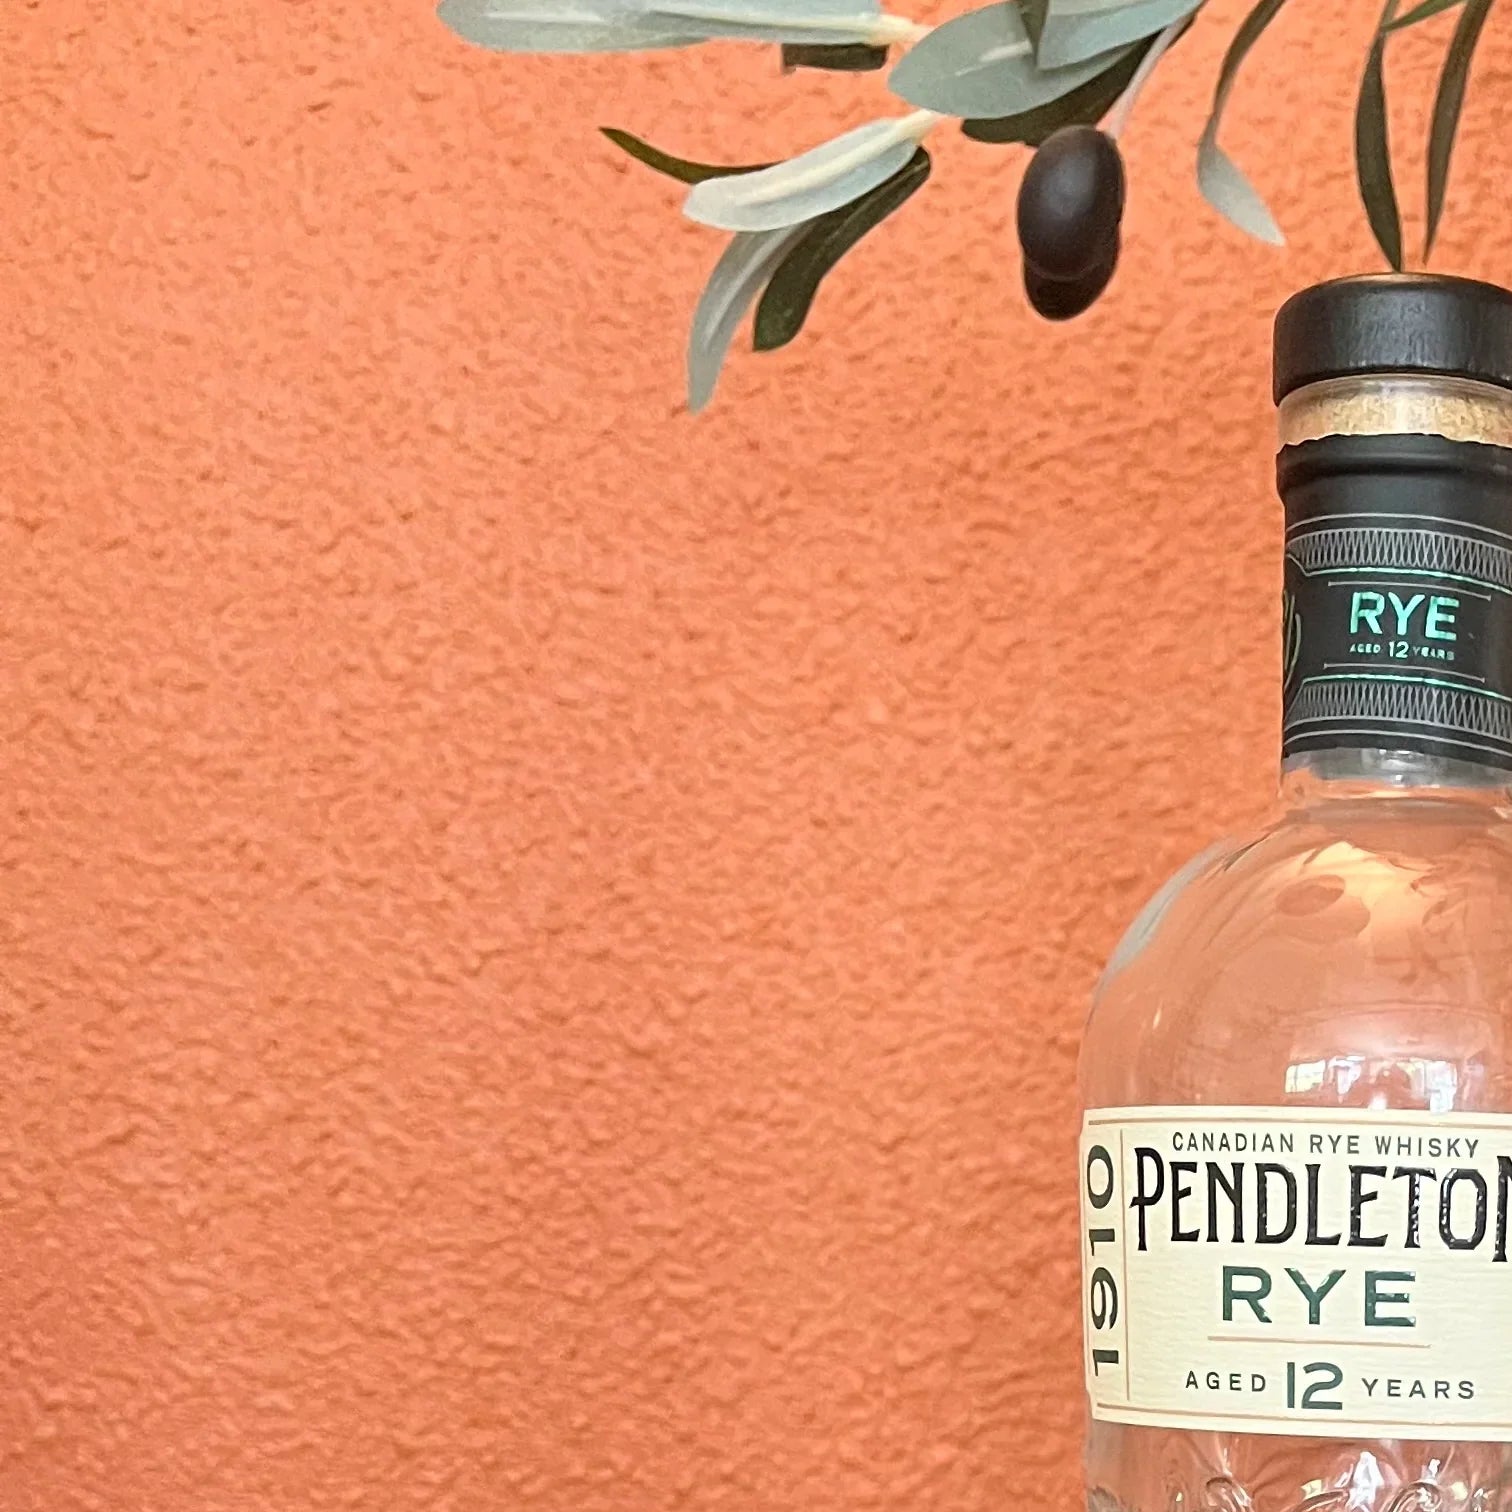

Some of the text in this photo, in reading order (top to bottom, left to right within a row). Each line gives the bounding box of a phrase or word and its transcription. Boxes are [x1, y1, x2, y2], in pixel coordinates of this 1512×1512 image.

[1350, 591, 1460, 641] RYE
[1350, 641, 1455, 661] AGED 12 YEARS
[1172, 1131, 1480, 1158] CANADIAN RYE WHISKY
[1087, 1144, 1120, 1377] 1910
[1222, 1265, 1416, 1327] RYE
[1185, 1361, 1475, 1410] AGED 12 YEARS
